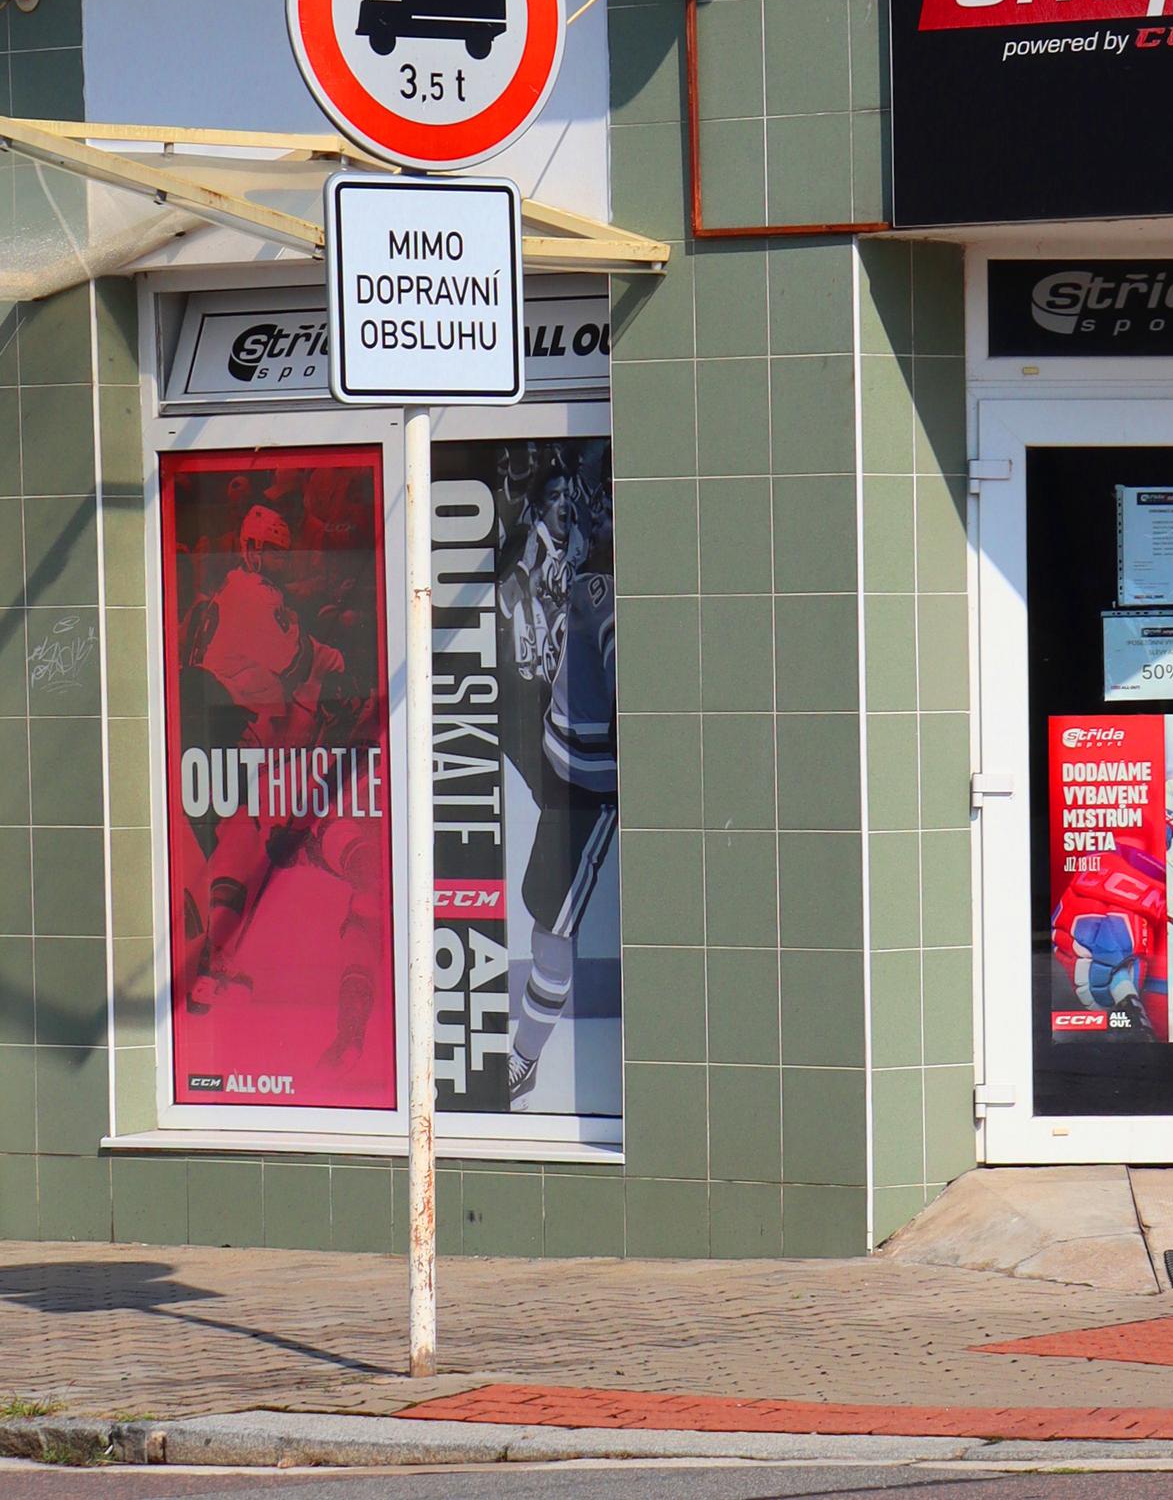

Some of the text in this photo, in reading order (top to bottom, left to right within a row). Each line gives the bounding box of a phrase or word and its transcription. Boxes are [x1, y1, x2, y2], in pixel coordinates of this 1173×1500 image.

[1002, 31, 1098, 61] powered
[1103, 29, 1131, 56] by
[400, 63, 466, 102] 3,5 t
[388, 230, 463, 261] MIMO
[356, 269, 500, 307] DOPRAVNÍ
[360, 319, 498, 351] OBSLUHU
[257, 365, 316, 382] spo
[1062, 760, 1152, 782] DODÁVÁME
[1063, 783, 1149, 805] VYBAVENÍ
[1063, 804, 1142, 828] MISTRŮM
[1063, 830, 1117, 852] SVĚTA
[1088, 856, 1101, 872] LET
[469, 927, 509, 1071] ALL
[1055, 1012, 1128, 1025] CCM ALL
[1110, 1019, 1132, 1028] OUT.
[190, 1074, 295, 1094] CCM ALL OUT.
